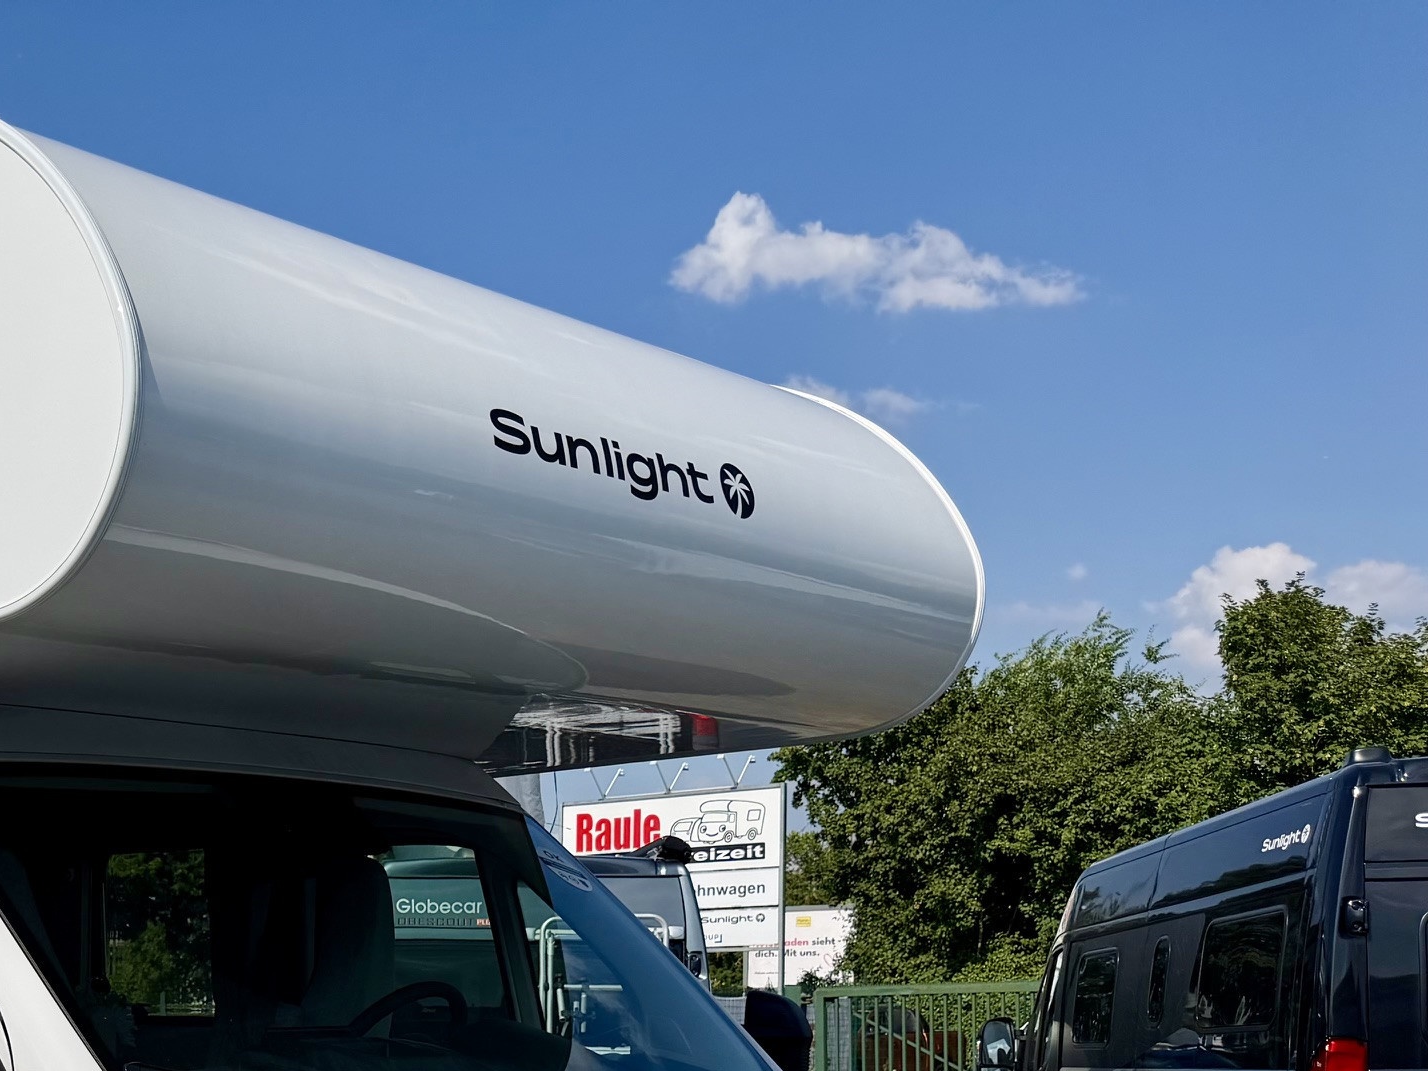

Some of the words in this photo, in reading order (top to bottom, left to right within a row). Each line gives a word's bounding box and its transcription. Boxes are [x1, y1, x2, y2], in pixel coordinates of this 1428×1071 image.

[489, 408, 715, 504] Sunlight
[576, 809, 661, 853] Raule
[1261, 829, 1301, 852] Sunlight
[690, 845, 764, 861] eizeit
[697, 884, 765, 897] hnwagen
[395, 898, 483, 914] Globecar
[701, 915, 753, 925] Sunlight
[785, 938, 809, 946] aden
[812, 937, 836, 946] sieht
[755, 950, 778, 958] dich.
[800, 949, 820, 957] uns.
